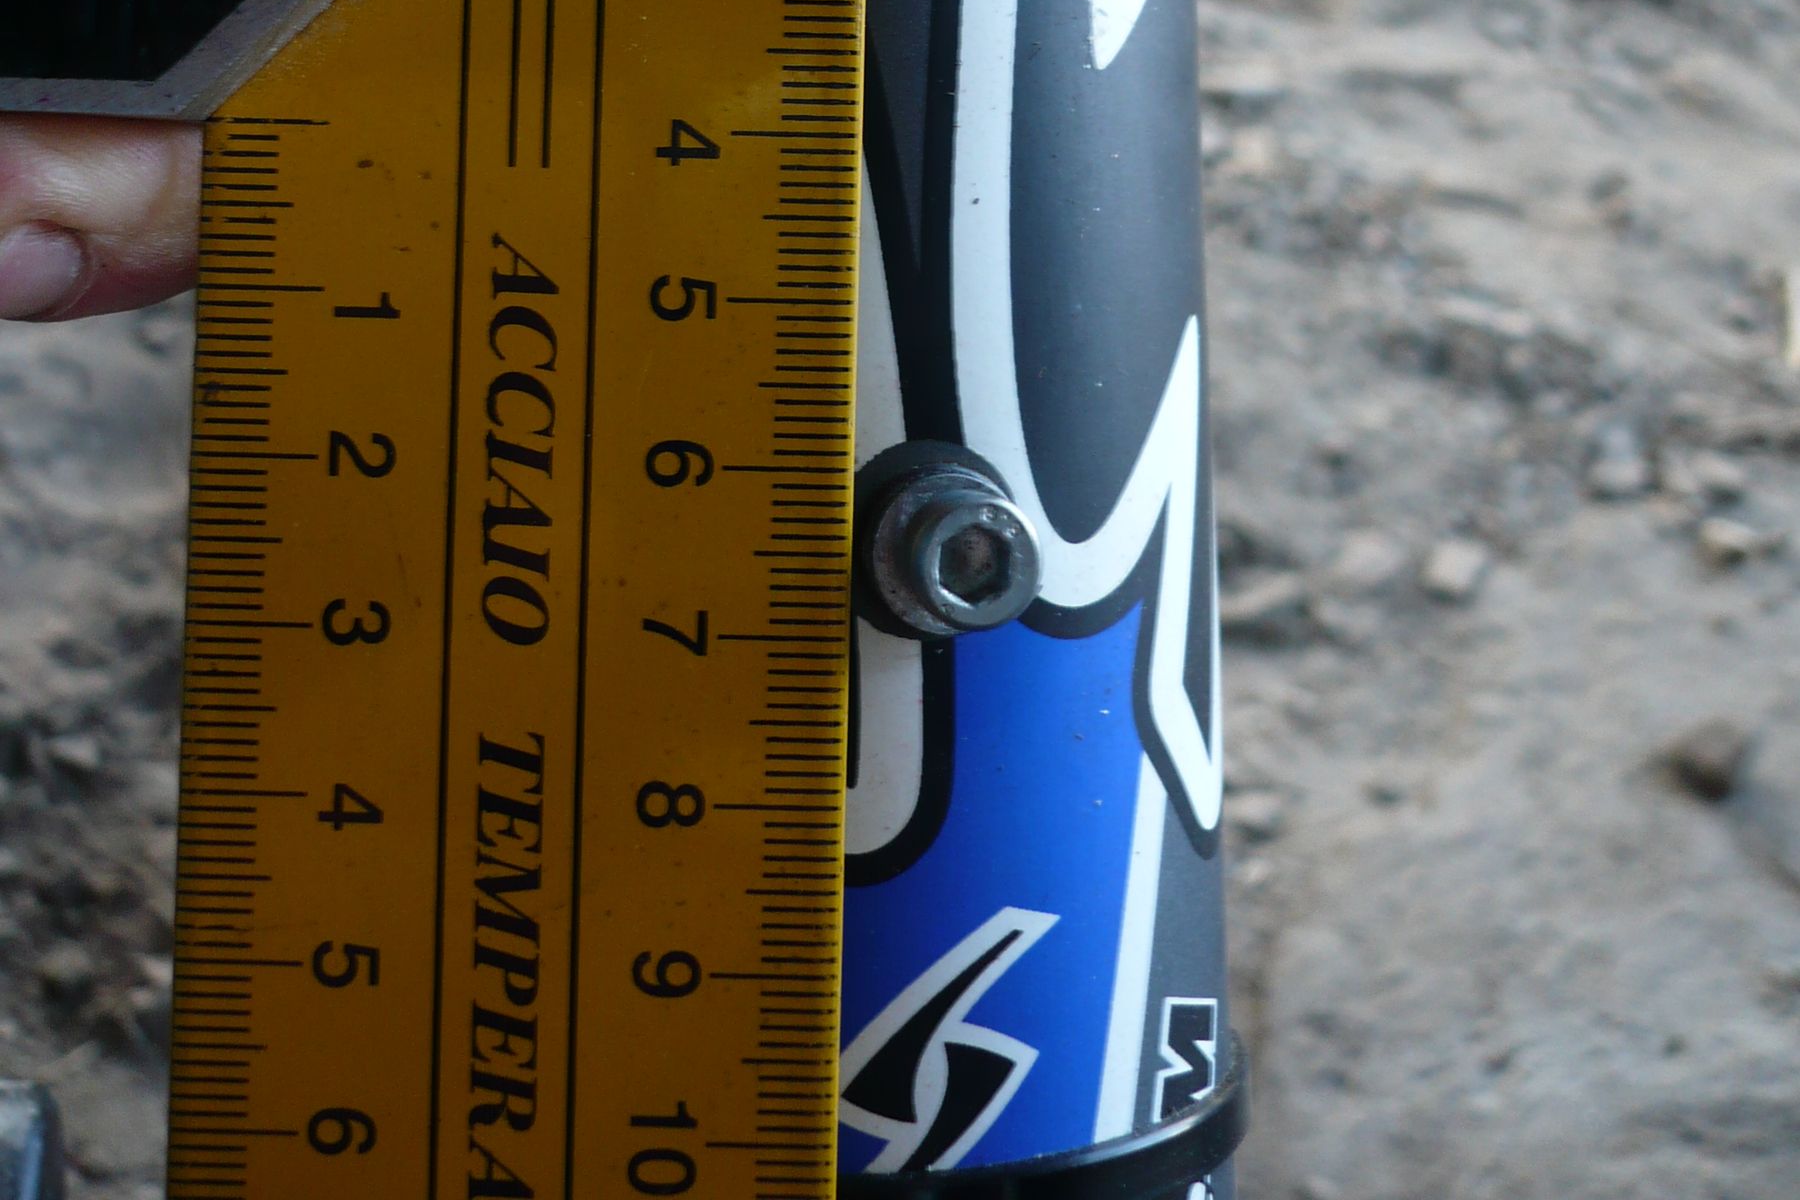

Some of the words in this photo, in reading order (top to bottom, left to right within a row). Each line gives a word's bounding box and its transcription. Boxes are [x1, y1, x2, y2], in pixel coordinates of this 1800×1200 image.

[656, 119, 720, 166] 4
[334, 292, 400, 319] 1
[649, 275, 716, 321] 5
[328, 431, 396, 478] 2
[481, 233, 559, 646] ACCIAIO
[645, 440, 714, 487] 6
[322, 599, 390, 646] 3
[643, 611, 708, 656] 7
[318, 784, 383, 831] 4
[636, 781, 705, 828] 8
[312, 941, 380, 988] 5
[631, 951, 701, 998] 9
[307, 1108, 376, 1155] 6
[627, 1101, 697, 1196] 10
